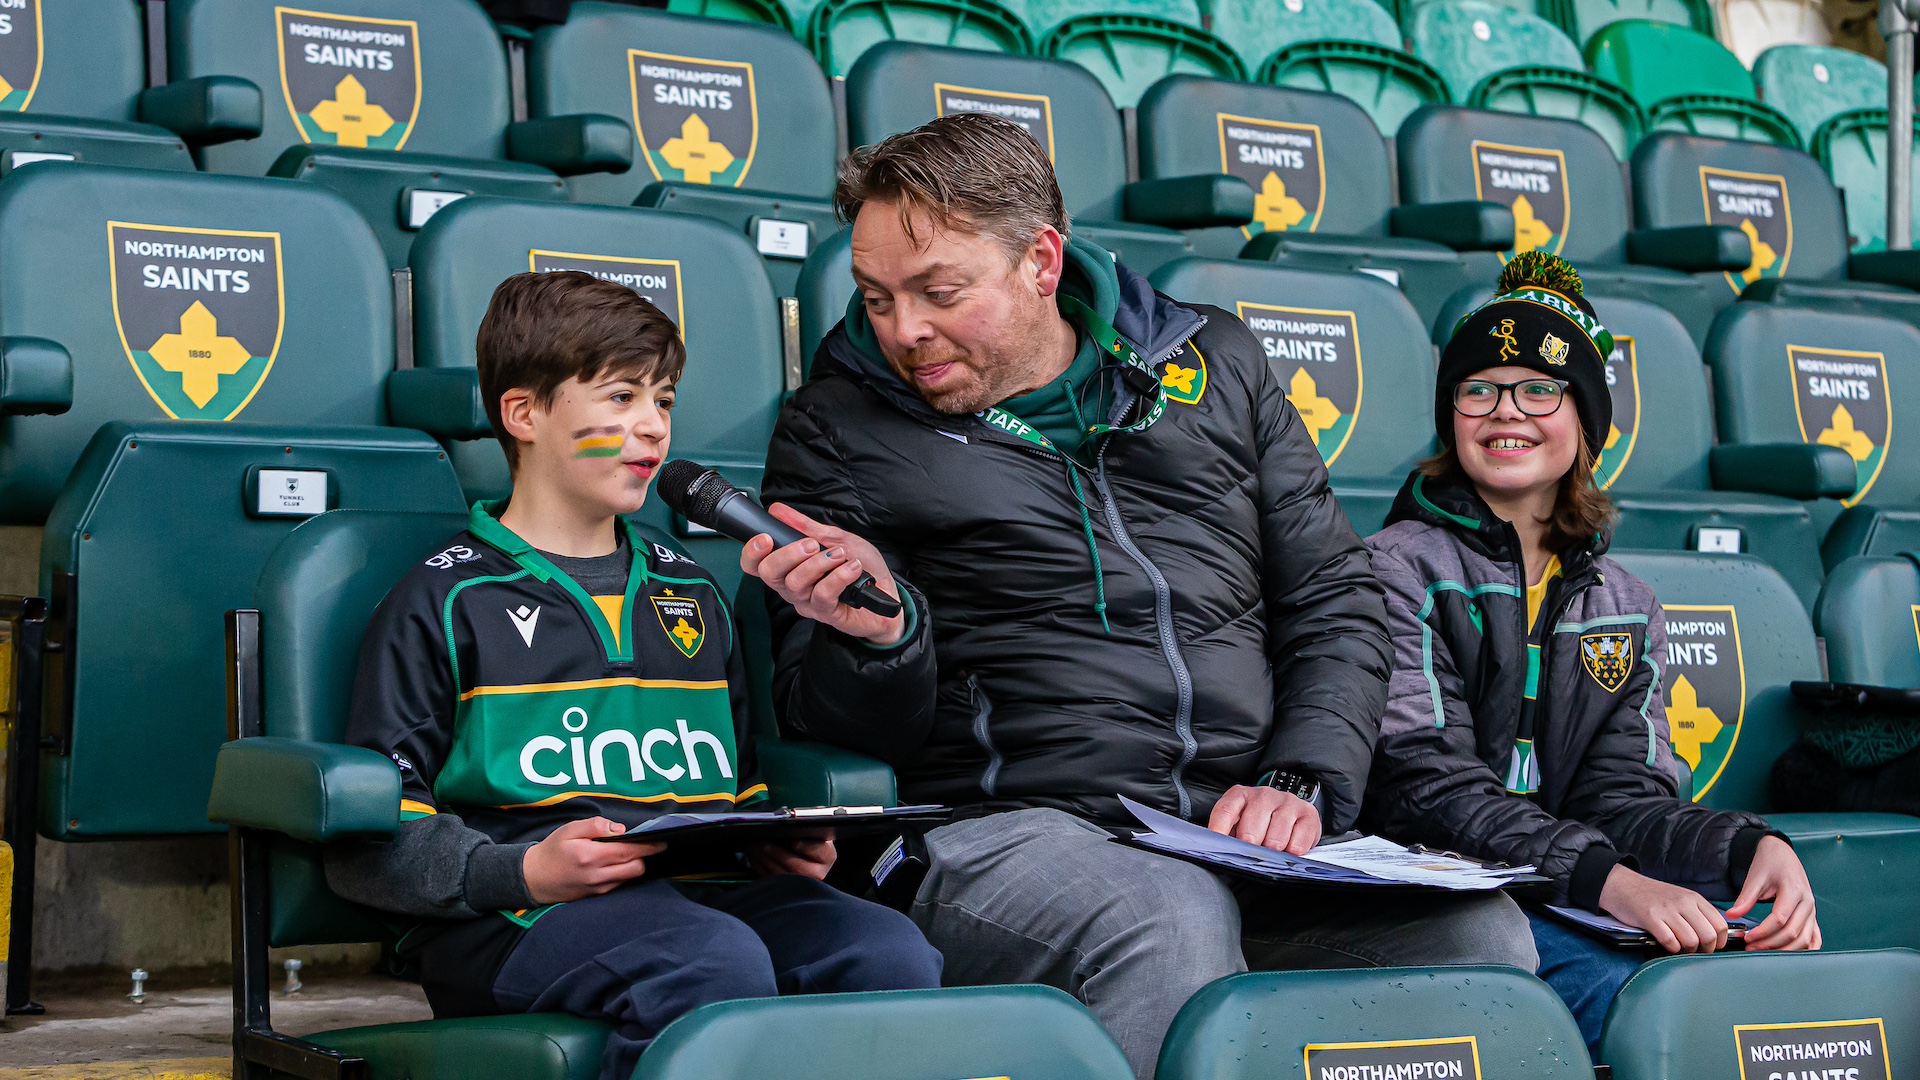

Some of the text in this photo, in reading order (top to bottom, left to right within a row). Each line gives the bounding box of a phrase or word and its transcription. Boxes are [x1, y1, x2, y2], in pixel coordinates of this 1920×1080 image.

[289, 22, 405, 47] NORTHAMPTON
[304, 42, 394, 71] SAINTS
[653, 83, 733, 111] SAINTS
[1238, 143, 1304, 169] SAINTS
[1490, 168, 1551, 193] SAINTS
[1717, 193, 1774, 218] SAINTS
[125, 240, 265, 263] NORTHAMPTON
[142, 264, 251, 294] SAINTS
[1249, 317, 1346, 337] NORTHAMPTON
[1519, 290, 1605, 339] ARMY
[188, 350, 212, 359] 1880
[1263, 336, 1338, 362] SAINTS
[1808, 376, 1870, 400] SAINTS
[663, 607, 694, 617] SAINTS
[1678, 720, 1695, 730] 1880
[519, 706, 734, 786] cinch
[1750, 1039, 1873, 1062] NORTHAMPTON
[1321, 1059, 1463, 1080] NORTHAMPTON
